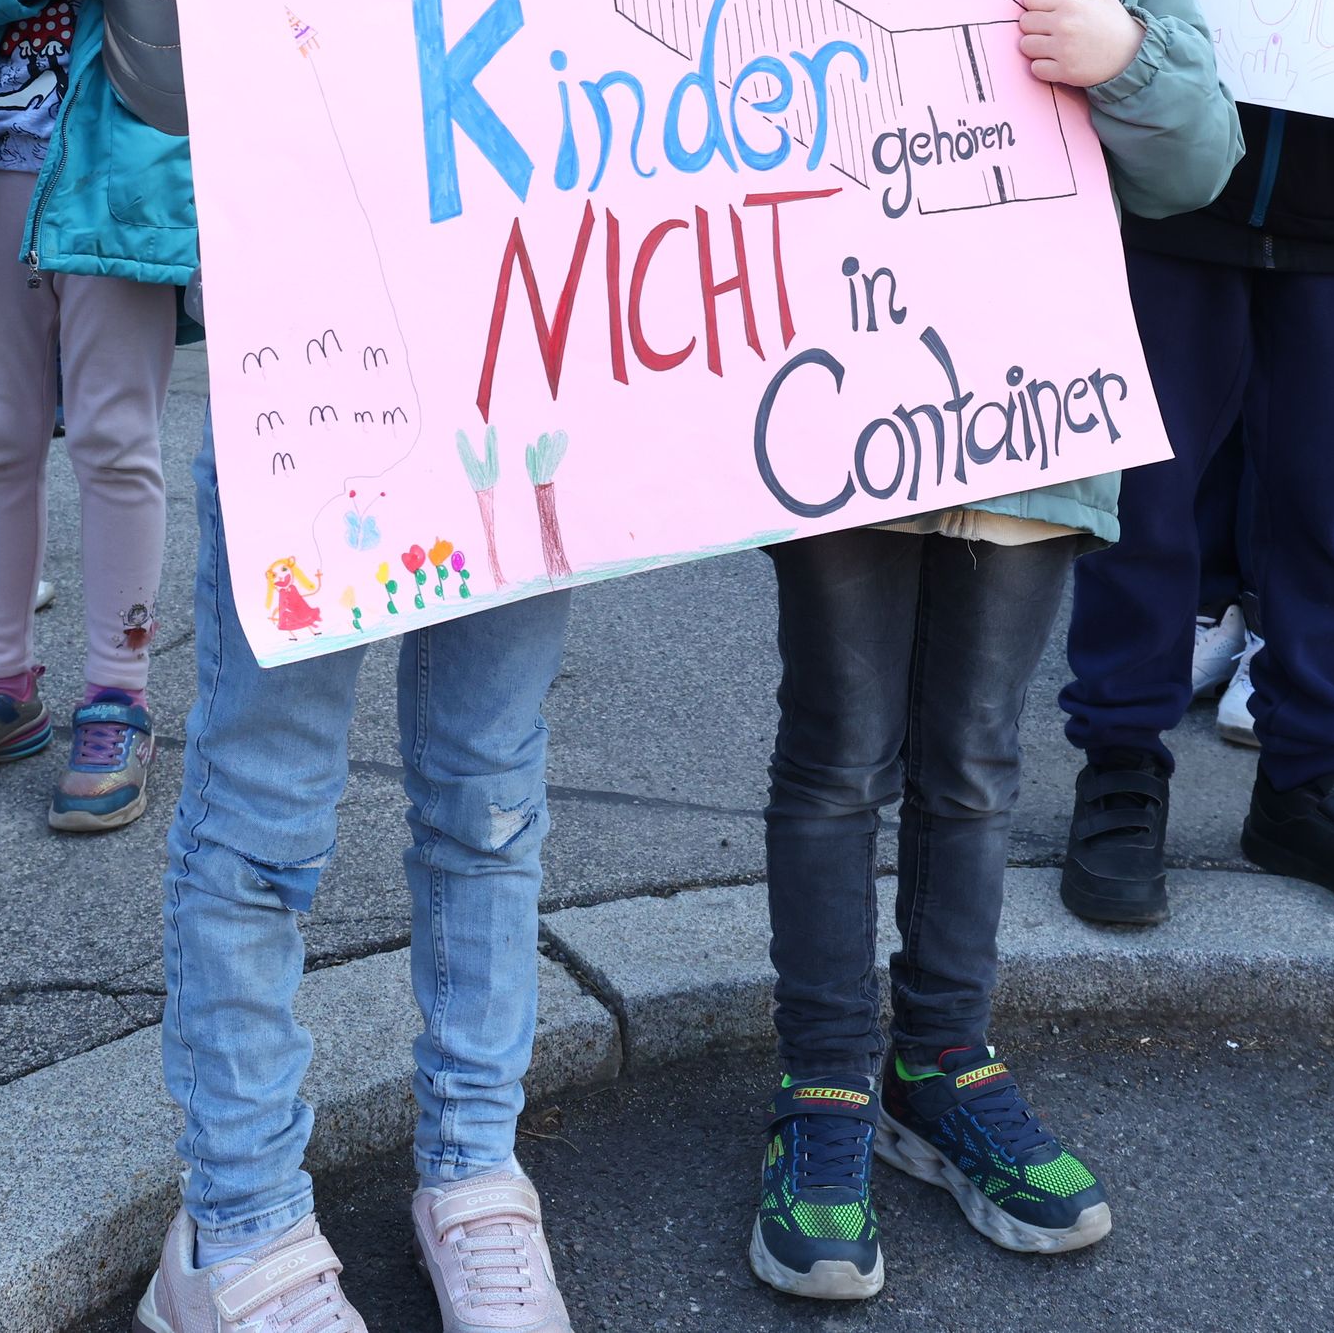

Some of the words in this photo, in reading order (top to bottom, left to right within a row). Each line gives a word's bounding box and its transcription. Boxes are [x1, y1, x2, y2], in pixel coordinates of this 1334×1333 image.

[872, 103, 1017, 219] gehören
[476, 189, 843, 422] NICHT
[841, 256, 908, 333] in
[753, 326, 1128, 519] Container
[957, 1062, 1008, 1087] SKECHER
[794, 1088, 869, 1104] SKECHERS
[467, 1192, 509, 1206] GEOX
[265, 1253, 308, 1281] GEOX
